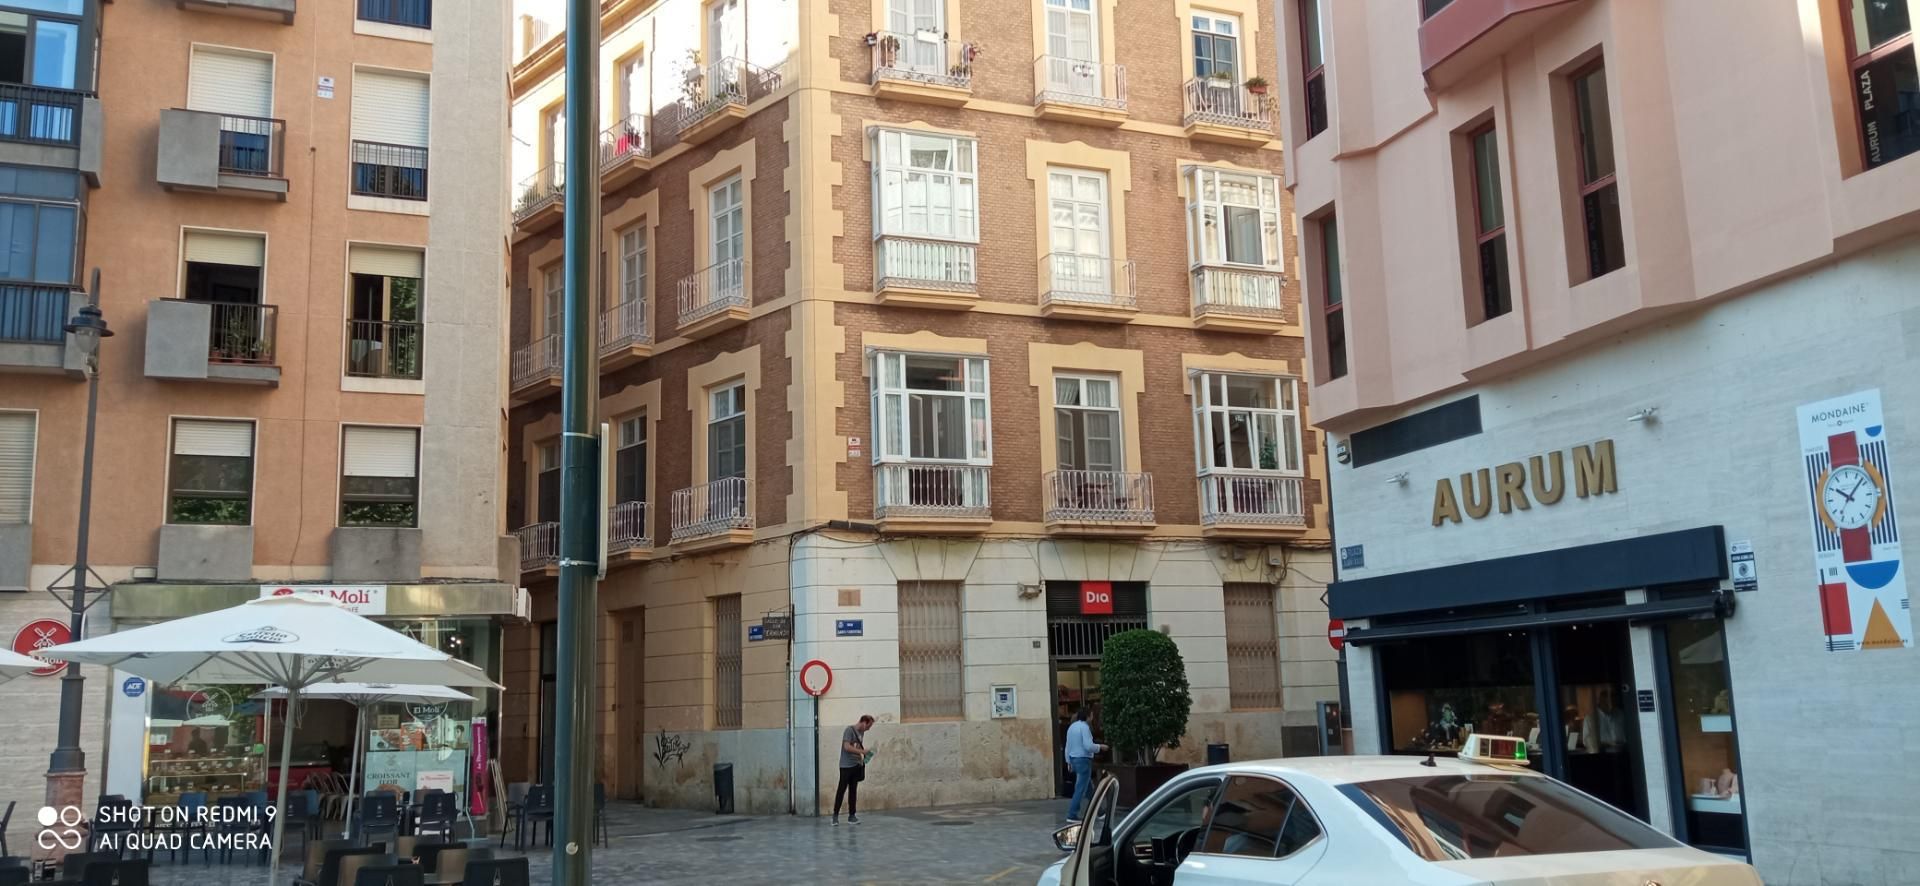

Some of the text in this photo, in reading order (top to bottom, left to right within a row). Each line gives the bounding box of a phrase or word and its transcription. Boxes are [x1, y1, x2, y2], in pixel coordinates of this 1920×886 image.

[1860, 69, 1880, 162] AURUM PLAZA
[1811, 403, 1866, 423] MONDAINE
[1432, 439, 1618, 527] AURUM
[126, 682, 142, 690] ADT
[413, 706, 421, 714] El
